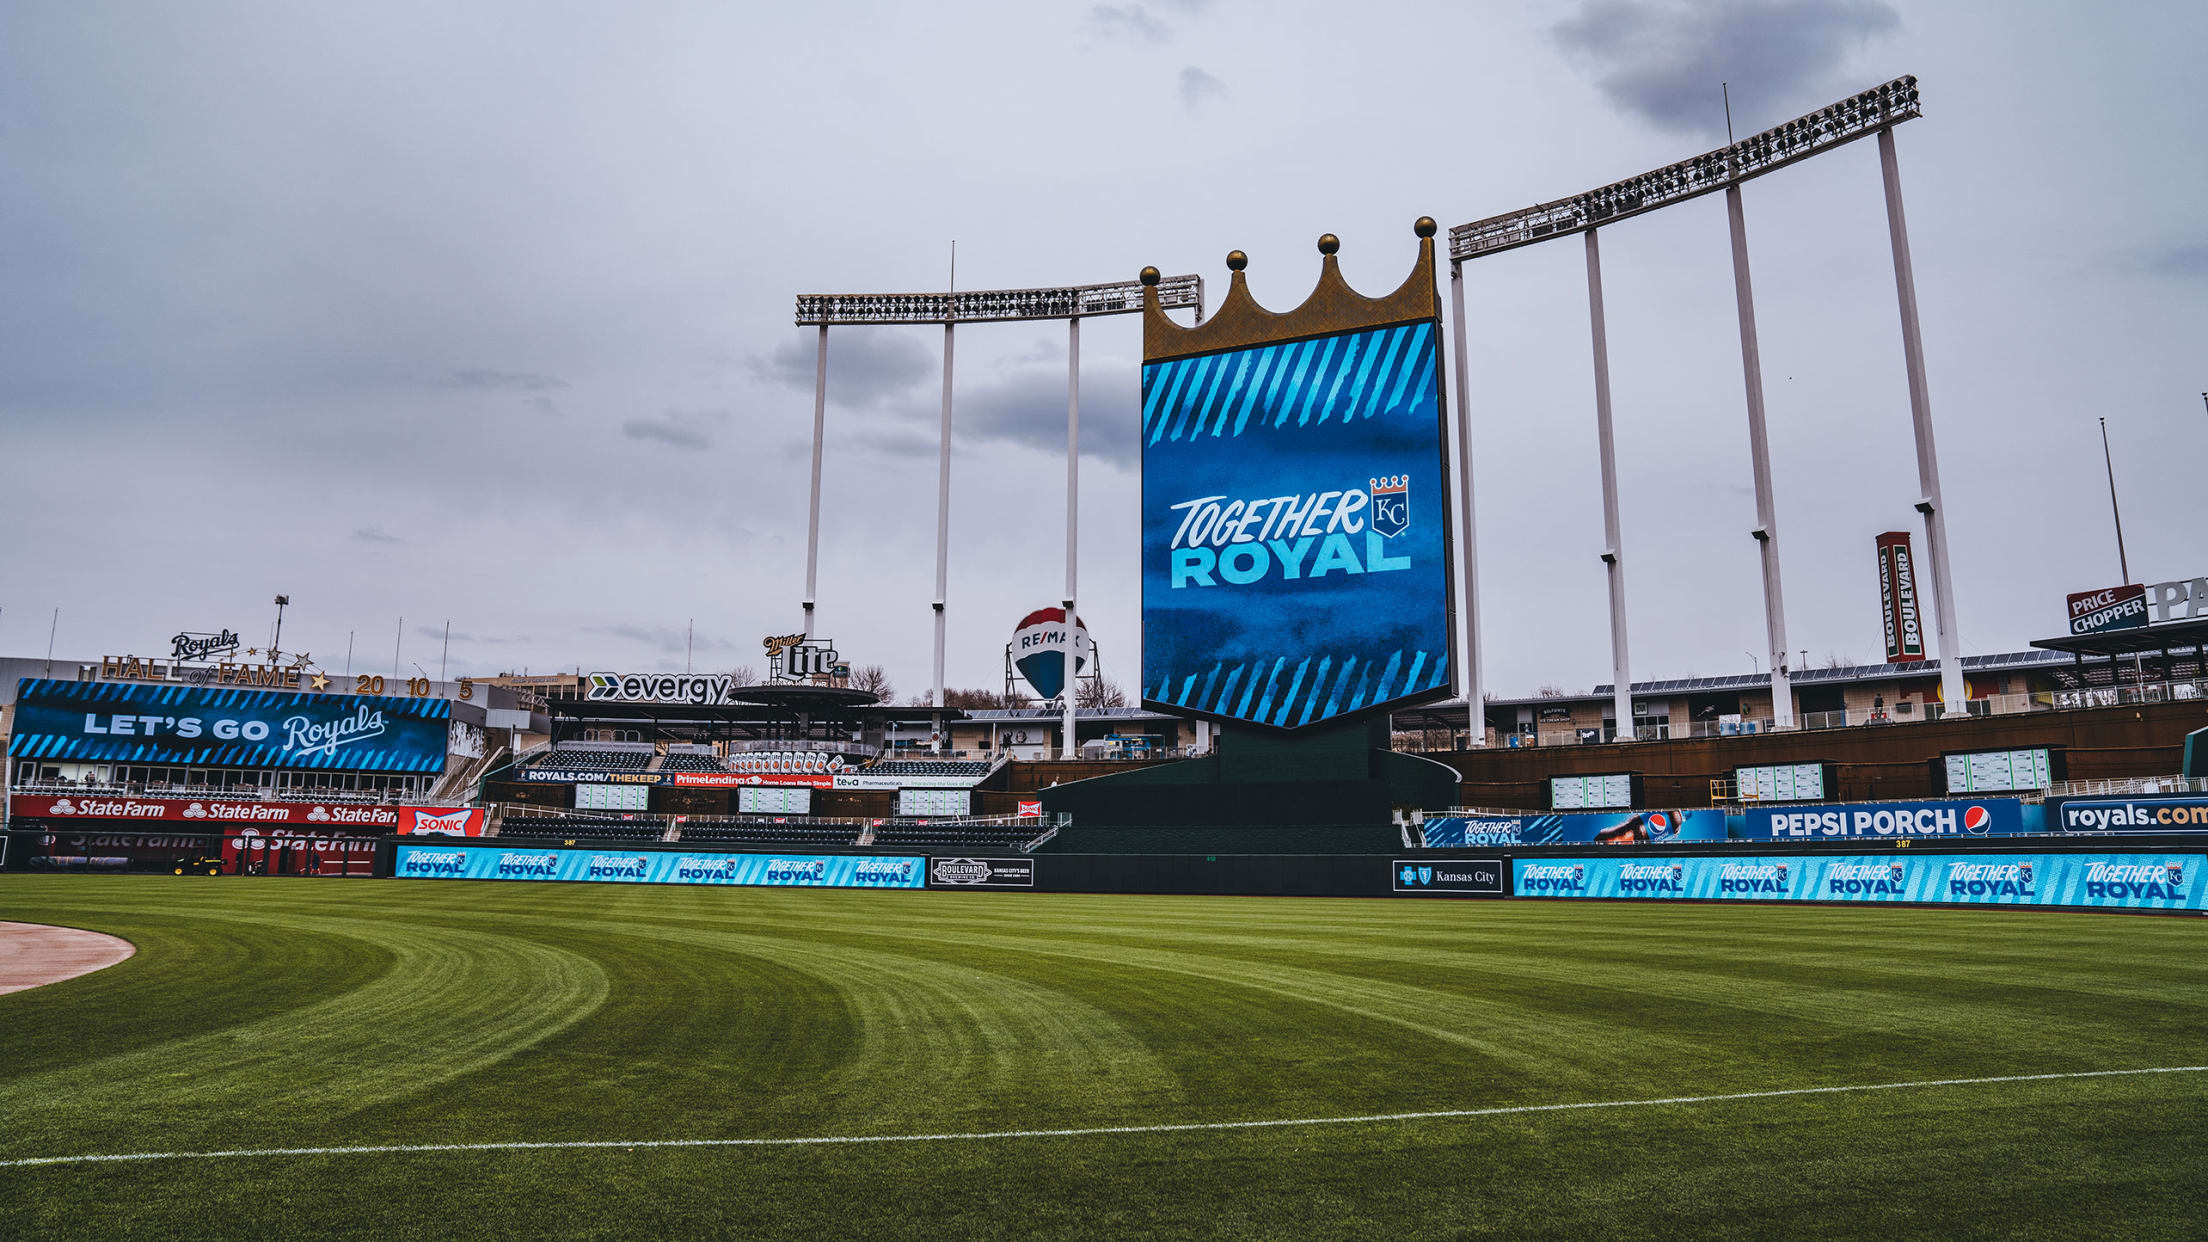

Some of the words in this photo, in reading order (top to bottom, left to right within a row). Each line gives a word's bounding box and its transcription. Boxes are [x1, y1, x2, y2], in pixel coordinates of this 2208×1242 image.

[1170, 488, 1369, 550] TOGETHER
[1170, 530, 1411, 590] ROYAL
[1880, 554, 1896, 648] BOULEVARD
[1896, 552, 1920, 646] BOULEVARD
[2071, 589, 2117, 615] PRICE
[2073, 599, 2146, 633] CHOPPER
[171, 629, 240, 660] Royals
[763, 634, 805, 656] Miller
[778, 646, 839, 681] Lite
[101, 655, 183, 682] HALL
[216, 662, 301, 688] FAME
[356, 674, 385, 696] 20
[407, 677, 431, 698] 10
[459, 680, 473, 699] 5
[623, 677, 730, 705] evergy
[84, 713, 203, 738] LET'S
[212, 718, 270, 741] GO
[282, 704, 385, 756] Royals
[529, 771, 662, 783] ROYALS.COM/THEKEEP
[676, 775, 745, 785] PrimeLending
[837, 777, 859, 787] teva
[330, 806, 398, 823] StateFar
[2069, 803, 2208, 830] royals.com
[418, 819, 463, 831] SONIC
[1464, 820, 1512, 834] TOGETHER
[1771, 812, 1848, 836] PEPSI
[1853, 809, 1957, 835] PORCH
[1464, 832, 1522, 844] ROYAL
[1895, 840, 1911, 848] 387
[406, 850, 457, 864] TOGETHER
[499, 852, 550, 866] TOGETHER
[590, 855, 638, 869] TOGETHER
[679, 857, 728, 871] TOGETHER
[406, 862, 465, 873] ROYAL
[499, 864, 557, 875] ROYAL
[589, 866, 646, 878] ROYAL
[679, 868, 735, 879] ROYAL
[768, 859, 815, 873] TOGETHER
[855, 861, 903, 874] TOGETHER
[941, 865, 984, 878] BOULEVARD
[1523, 864, 1574, 879] TOGETHER
[1619, 863, 1672, 880] TOGETHER
[1720, 863, 1777, 881] TOGETHER
[1829, 862, 1890, 881] TOGETHER
[1948, 862, 2019, 881] TOGETHER
[2084, 861, 2166, 885] TOGETHER
[768, 870, 823, 881] ROYAL
[855, 872, 911, 883] ROYAL
[1436, 871, 1473, 882] Kansas
[1474, 871, 1496, 885] City
[1523, 878, 1584, 891] ROYAL
[1620, 878, 1683, 892] ROYAL
[1721, 879, 1789, 893] ROYAL
[1830, 879, 1905, 894] ROYAL
[1949, 879, 2035, 896] ROYAL
[2086, 880, 2186, 900] ROYAL
